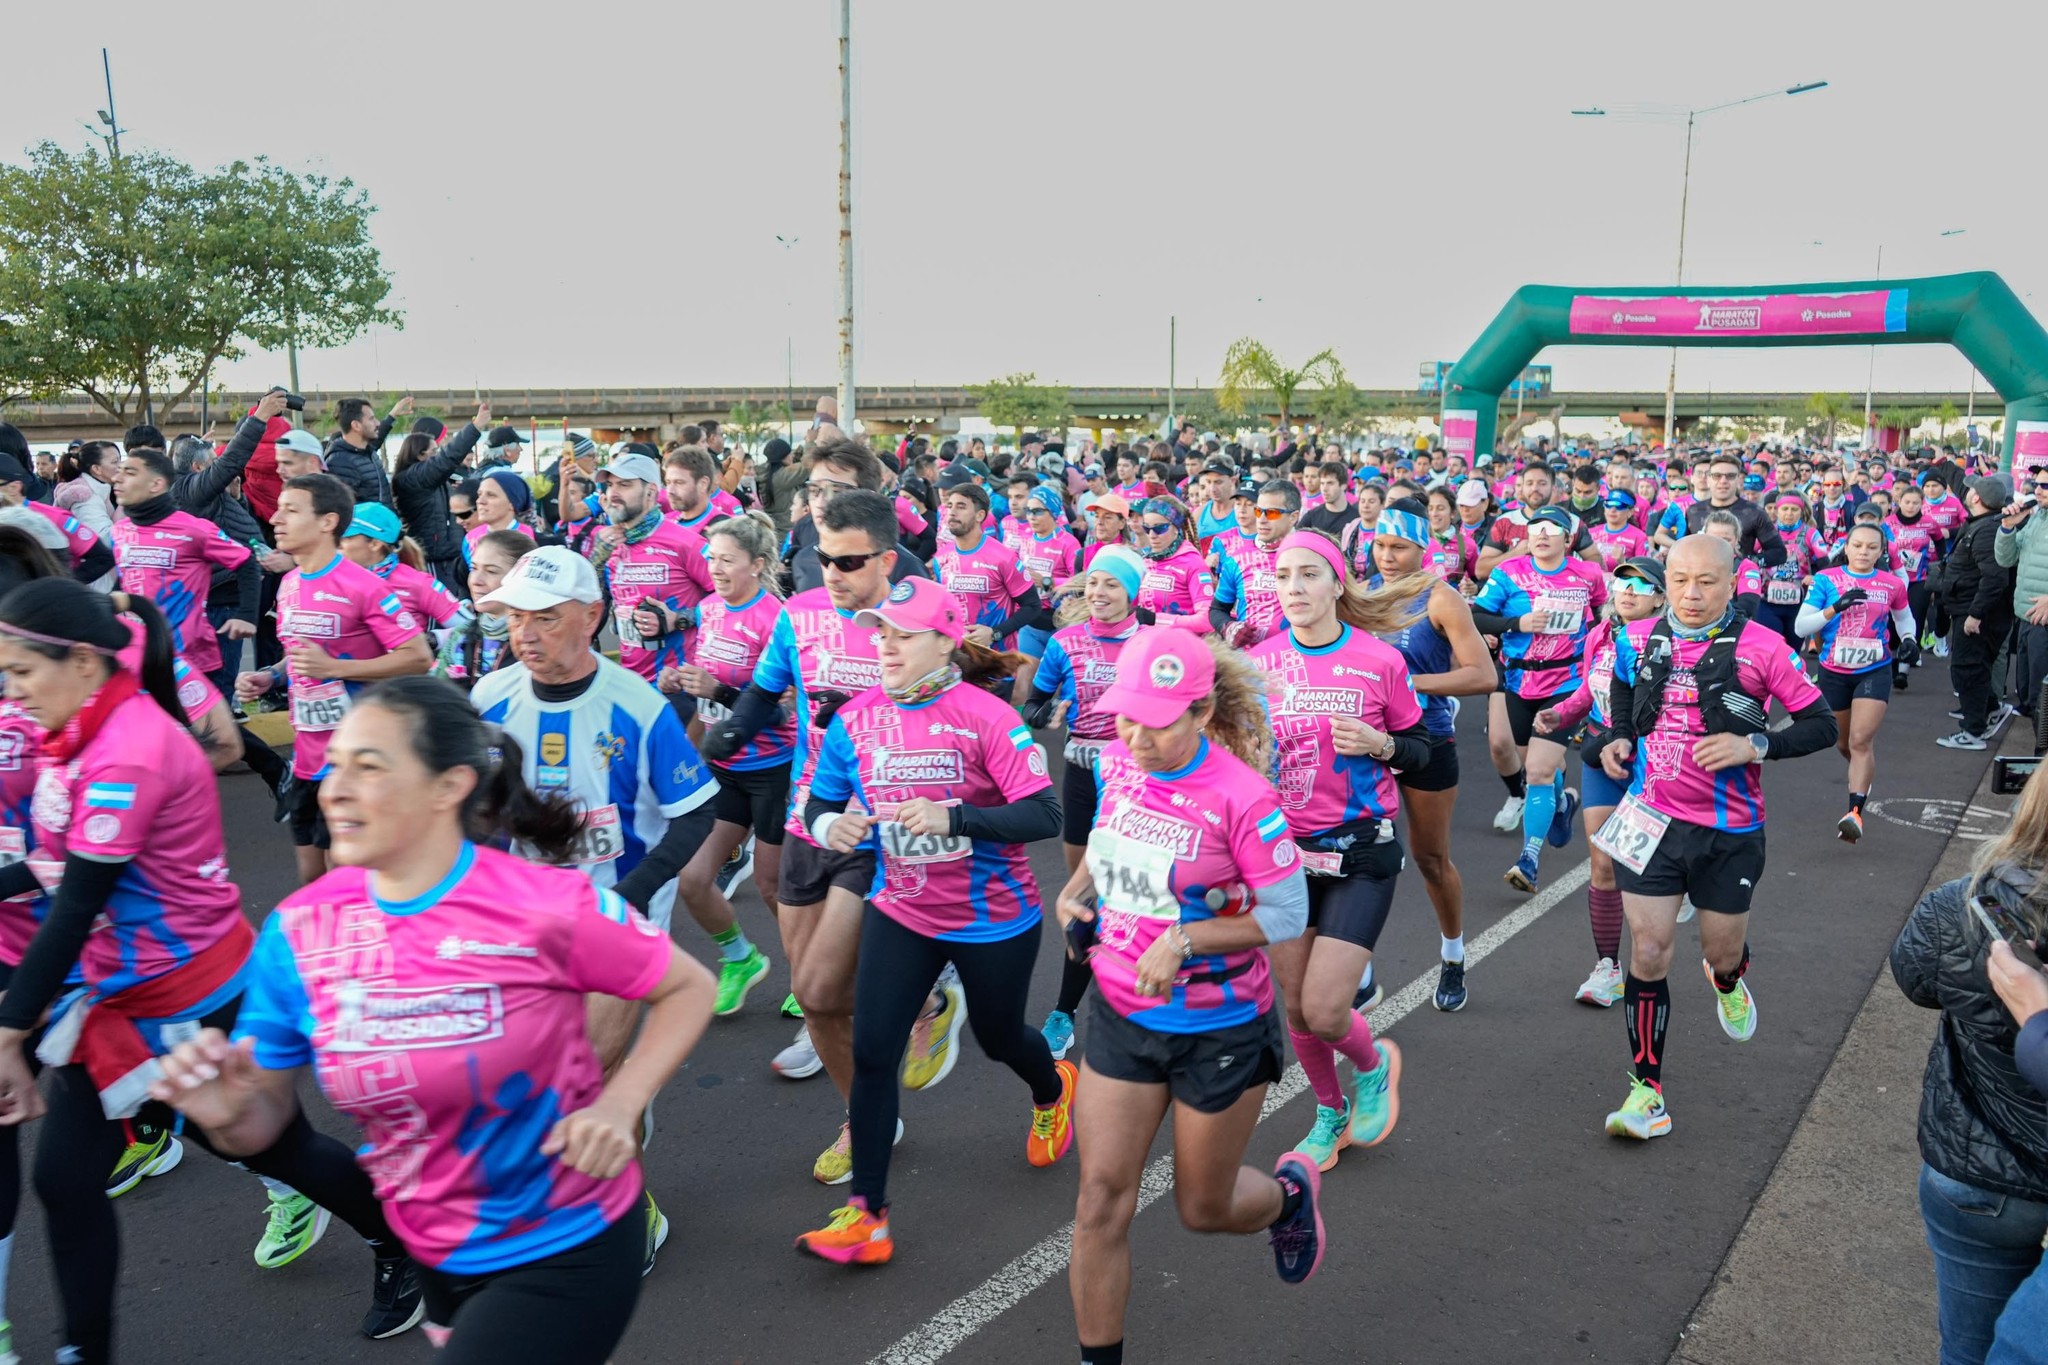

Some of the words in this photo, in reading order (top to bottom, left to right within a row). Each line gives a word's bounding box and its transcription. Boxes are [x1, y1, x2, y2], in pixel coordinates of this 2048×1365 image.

[1625, 314, 1656, 323] Posadas
[1711, 308, 1756, 318] MARATÓN
[1816, 310, 1852, 319] Posadas
[1711, 318, 1756, 328] POSADAS
[1772, 589, 1797, 602] 1054
[1546, 610, 1576, 630] 117
[1840, 647, 1878, 664] 1724
[1346, 667, 1381, 682] Posadas
[1298, 690, 1357, 703] MARATÓN
[1296, 701, 1356, 713] POSADAS
[889, 752, 956, 768] MARATÓN
[887, 766, 957, 781] POSADAS
[1127, 811, 1194, 843] MARATÓN
[1099, 858, 1159, 908] 744
